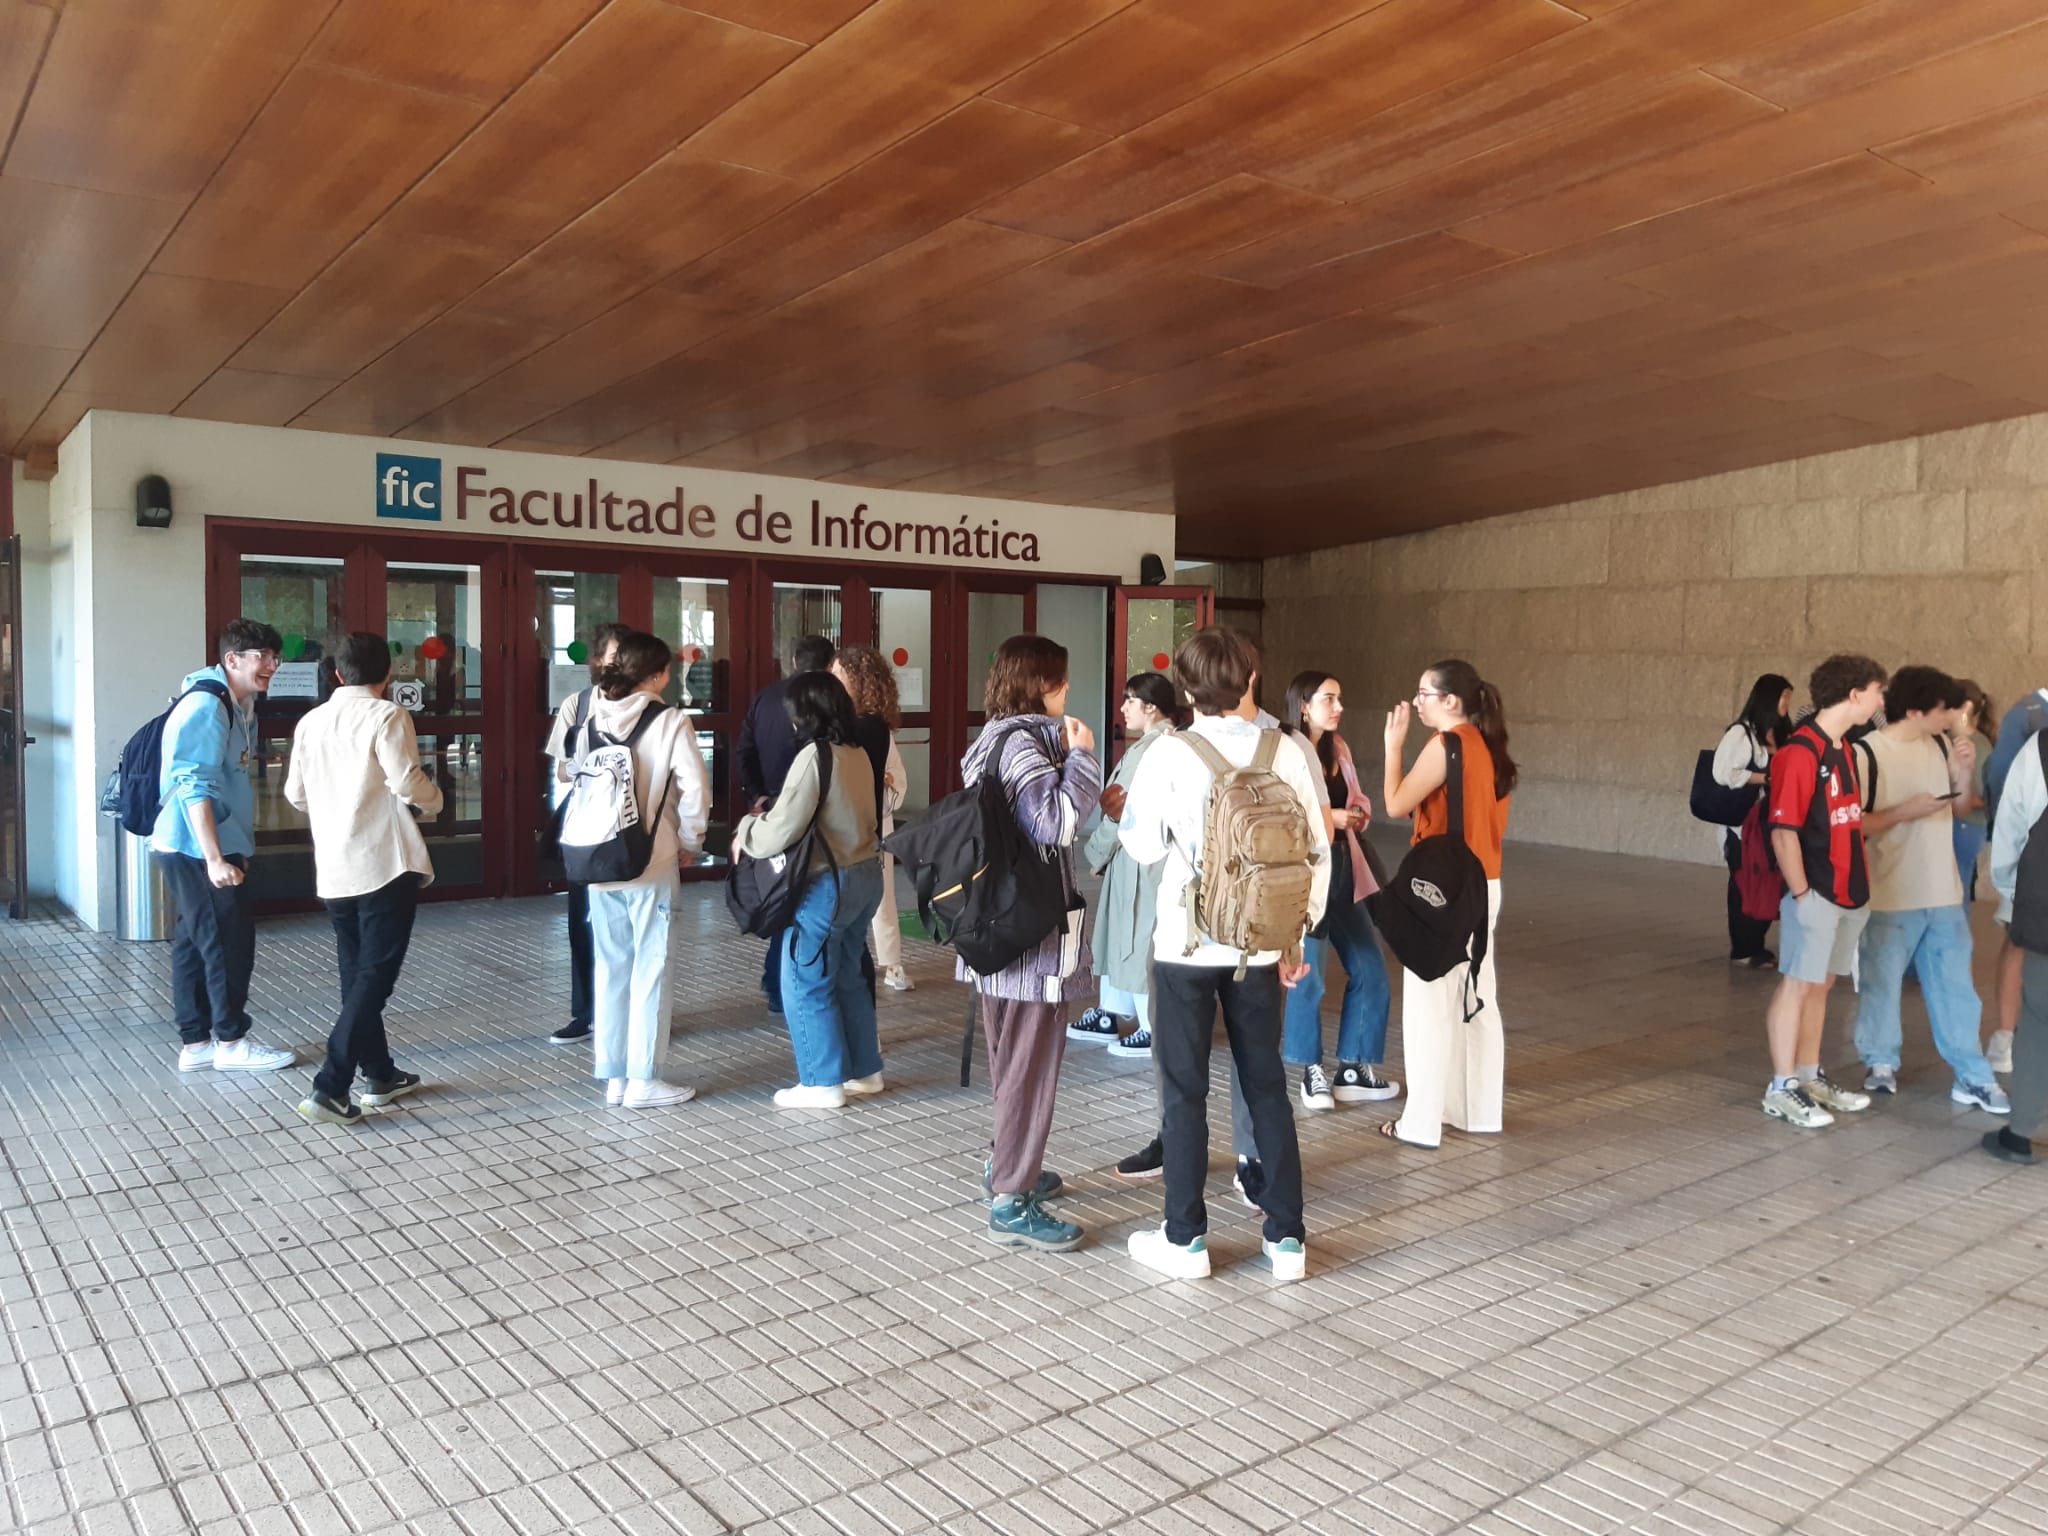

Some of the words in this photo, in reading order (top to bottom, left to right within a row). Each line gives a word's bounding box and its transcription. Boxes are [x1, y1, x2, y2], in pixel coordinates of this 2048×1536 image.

[382, 465, 436, 509] fic
[456, 465, 717, 538] Facultade
[735, 494, 793, 544] de
[811, 499, 1041, 562] Informática
